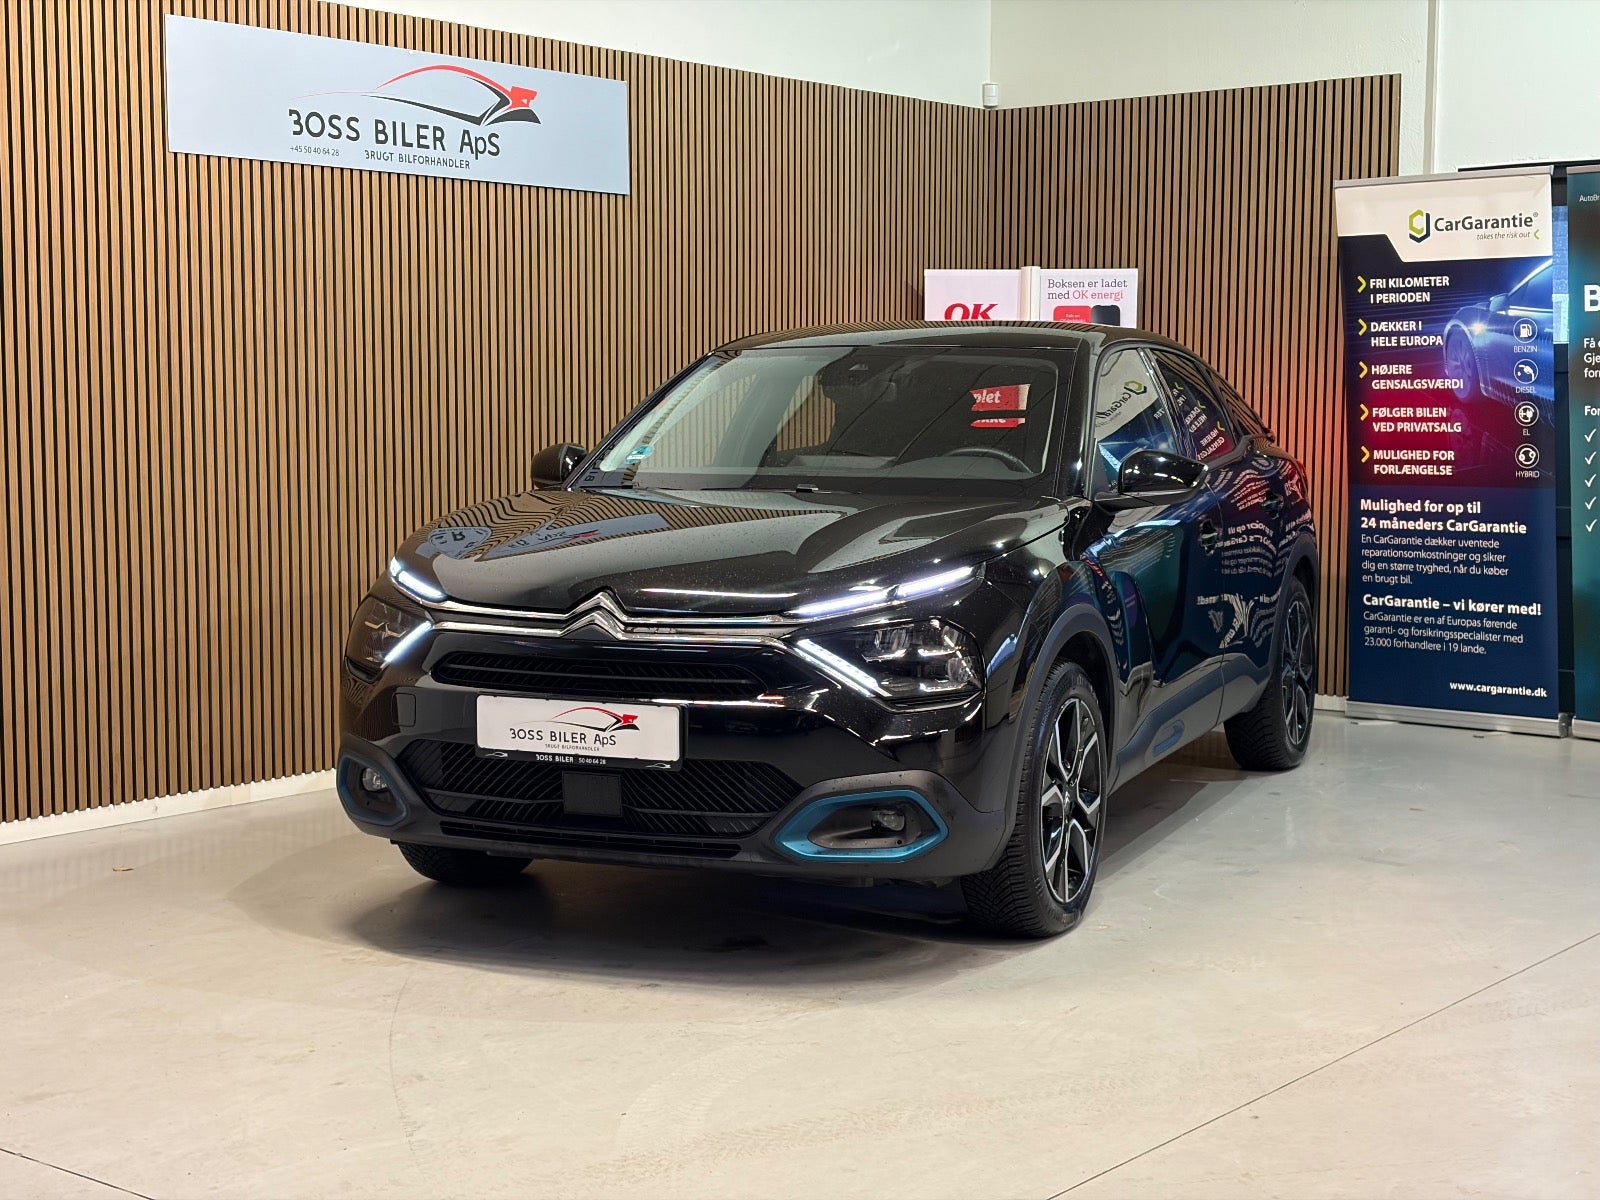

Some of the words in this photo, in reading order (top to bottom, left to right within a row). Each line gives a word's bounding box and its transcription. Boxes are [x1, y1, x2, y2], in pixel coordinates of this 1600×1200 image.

[288, 108, 360, 141] BOSS
[375, 119, 446, 151] BILER
[459, 129, 500, 160] ApS
[399, 153, 470, 169] BILFORHANDLER
[1048, 279, 1085, 288] Boksen
[1101, 278, 1128, 288] ladet
[1370, 278, 1386, 288] FRI
[1389, 276, 1449, 288] KILOMETER
[1048, 290, 1070, 299] med
[1072, 290, 1088, 299] OK
[1091, 291, 1123, 301] energi
[1370, 294, 1373, 304] I
[1376, 292, 1430, 303] PERIODEN
[944, 303, 998, 320] OK
[1370, 321, 1416, 332] DÆKKER
[1419, 321, 1422, 331] I
[1371, 337, 1397, 347] HELE
[1400, 336, 1443, 346] EUROPA
[1584, 338, 1595, 348] Få
[1371, 364, 1412, 375] HØJERE
[1372, 379, 1464, 390] GENSALGSVÆRDI
[1372, 407, 1414, 418] FØLGER
[1416, 407, 1447, 418] BILEN
[1373, 422, 1394, 432] VED
[1397, 422, 1462, 432] PRIVATSALG
[1373, 450, 1430, 460] MULIGHED
[1433, 451, 1455, 461] FOR
[1374, 465, 1453, 475] FORLÆNGELSE
[1360, 499, 1421, 514] Mulighed
[1424, 500, 1444, 513] for
[1446, 504, 1464, 515] op
[1467, 501, 1481, 514] til
[1360, 517, 1376, 529] 24
[1380, 517, 1444, 531] måneders
[1446, 520, 1527, 534] CarGarantie
[1361, 535, 1371, 544] En
[1373, 535, 1422, 545] CarGarantie
[1424, 536, 1456, 547] dækker
[1458, 538, 1499, 548] uventede
[1361, 548, 1467, 562] reparationsomkostninger
[1468, 553, 1480, 563] og
[1482, 552, 1506, 562] sikrer
[1361, 560, 1375, 571] dig
[1390, 562, 1414, 571] større
[1416, 563, 1451, 575] tryghed,
[1453, 564, 1467, 573] når
[1469, 565, 1481, 574] du
[1483, 566, 1509, 576] køber
[1375, 573, 1398, 585] brugt
[1363, 593, 1440, 610] CarGarantie
[1453, 600, 1465, 611] vi
[1468, 599, 1504, 613] kører
[1507, 603, 1542, 616] med!
[1363, 611, 1412, 623] CarGarantie
[1436, 615, 1445, 625] af
[1447, 616, 1481, 628] Europas
[1483, 618, 1518, 630] førende
[1364, 626, 1395, 636] garanti-
[1397, 628, 1409, 637] og
[1411, 628, 1501, 642] forsikringsspecialister
[1503, 634, 1523, 644] med
[1365, 637, 1392, 647] 23.000
[1393, 639, 1441, 651] forhandlere
[1449, 642, 1459, 652] 19
[1460, 643, 1487, 654] lande.
[1450, 682, 1547, 698] www.cargarantie.dk
[550, 731, 587, 744] BILER
[594, 734, 616, 747] ApS
